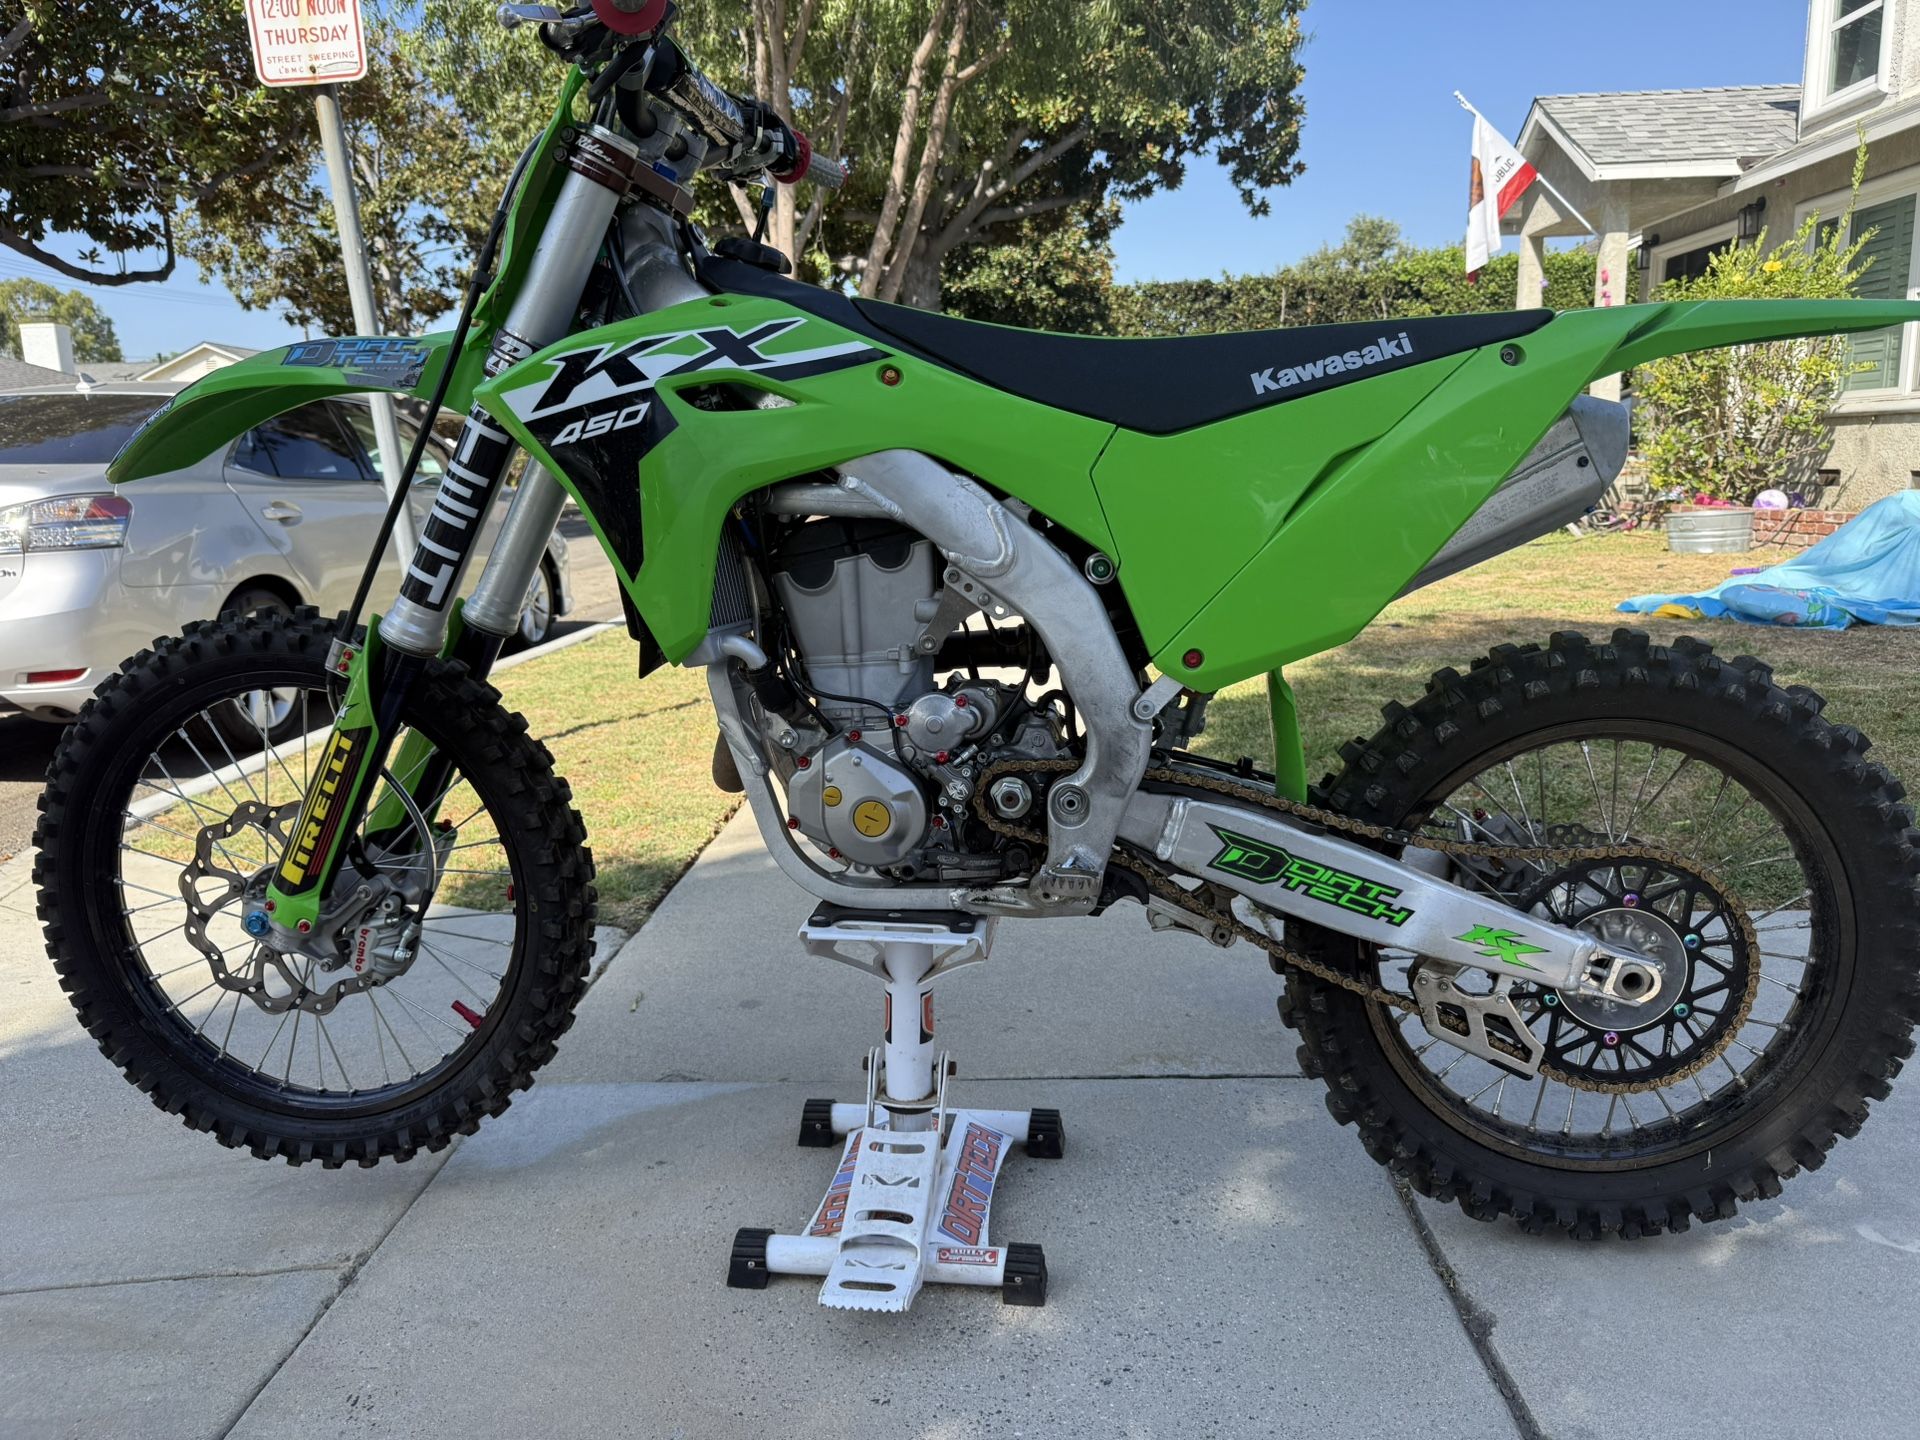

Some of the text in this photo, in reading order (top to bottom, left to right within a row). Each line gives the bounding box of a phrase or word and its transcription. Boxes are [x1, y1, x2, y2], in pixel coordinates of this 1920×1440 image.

[307, 0, 347, 16] NOON
[264, 24, 349, 46] THURSDAY
[266, 50, 356, 64] STREET SWEEPING
[530, 316, 809, 414] KX
[1250, 332, 1413, 395] Kawasaki
[550, 402, 652, 447] 450
[281, 728, 354, 886] PIRELLI
[1284, 872, 1411, 925] TECH
[354, 928, 371, 972] brembo
[1453, 923, 1551, 972] KX
[957, 1121, 1002, 1182] TECH
[941, 1172, 989, 1246] DIRT
